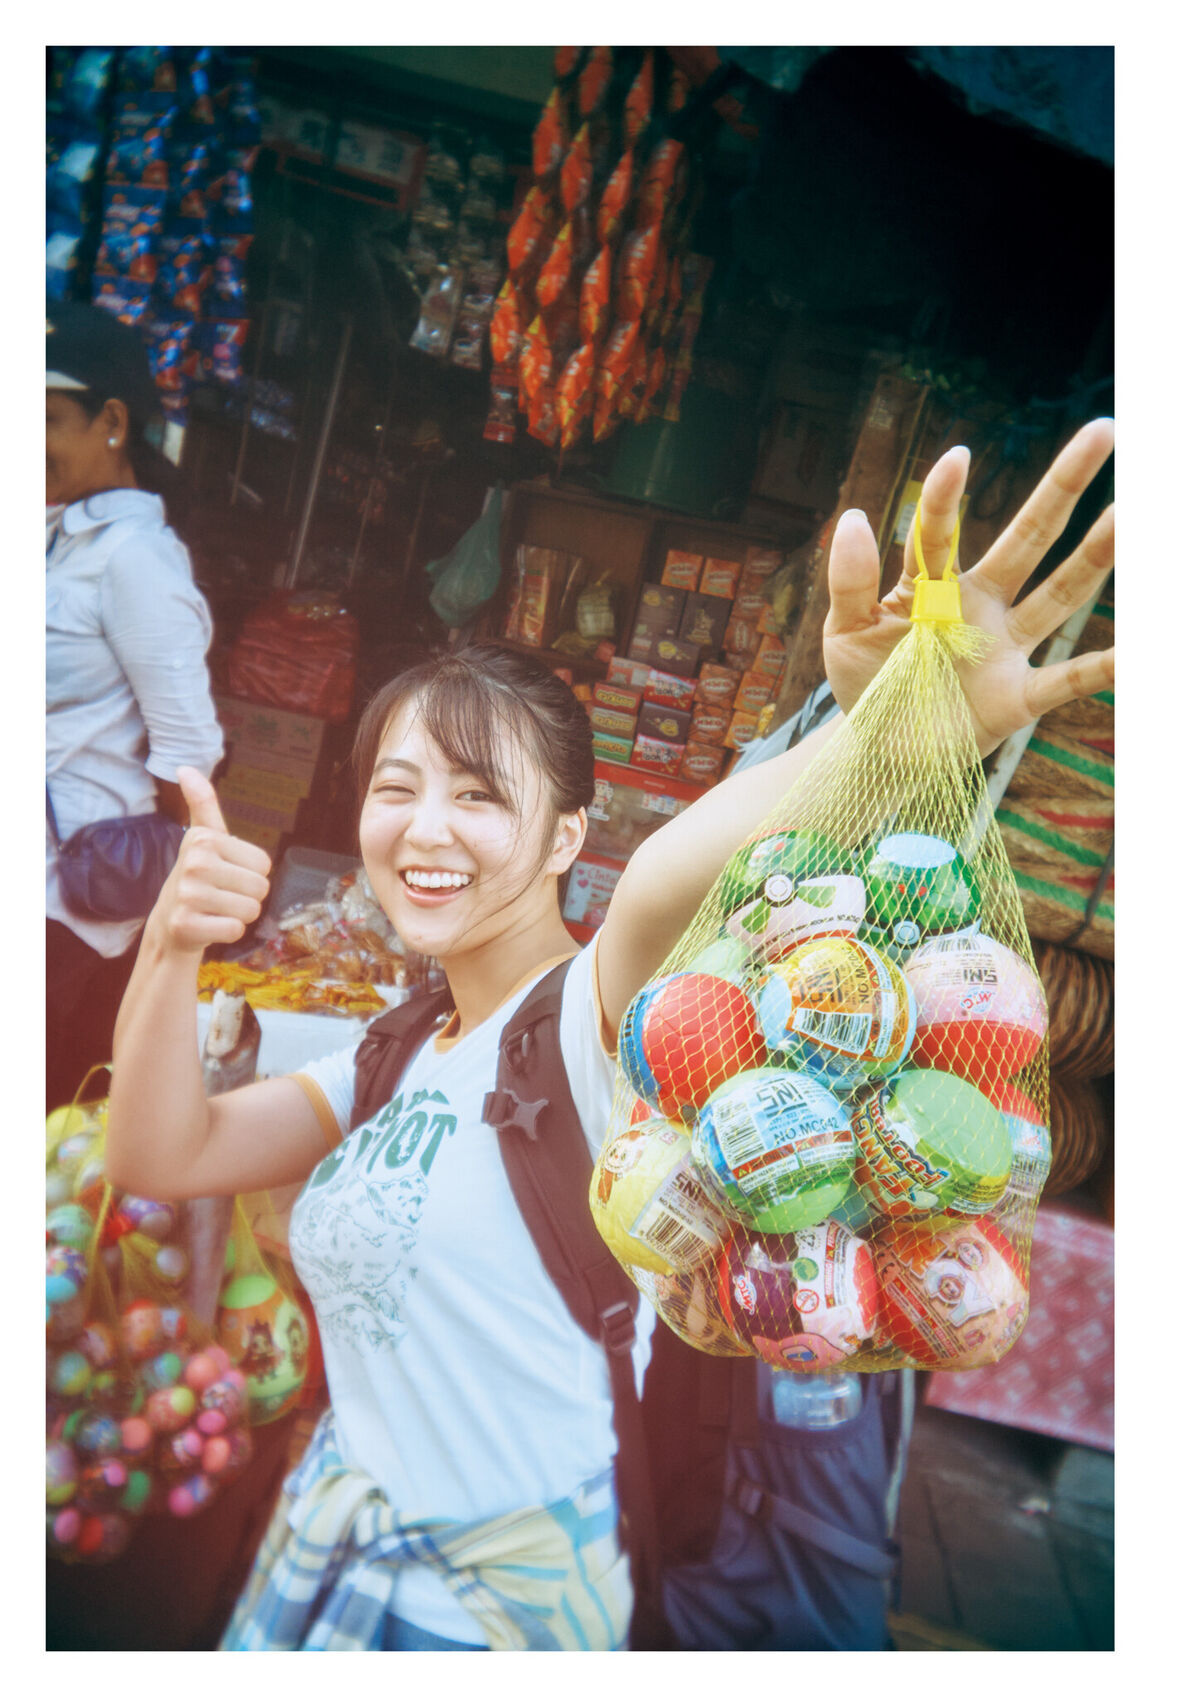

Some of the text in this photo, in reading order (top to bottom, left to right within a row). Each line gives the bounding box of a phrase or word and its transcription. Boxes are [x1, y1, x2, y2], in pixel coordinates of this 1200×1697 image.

[963, 968, 998, 983] SNI
[961, 991, 993, 1010] MTC
[755, 1080, 805, 1111] SNI
[674, 1172, 702, 1202] SNI
[737, 1278, 754, 1311] MTC
